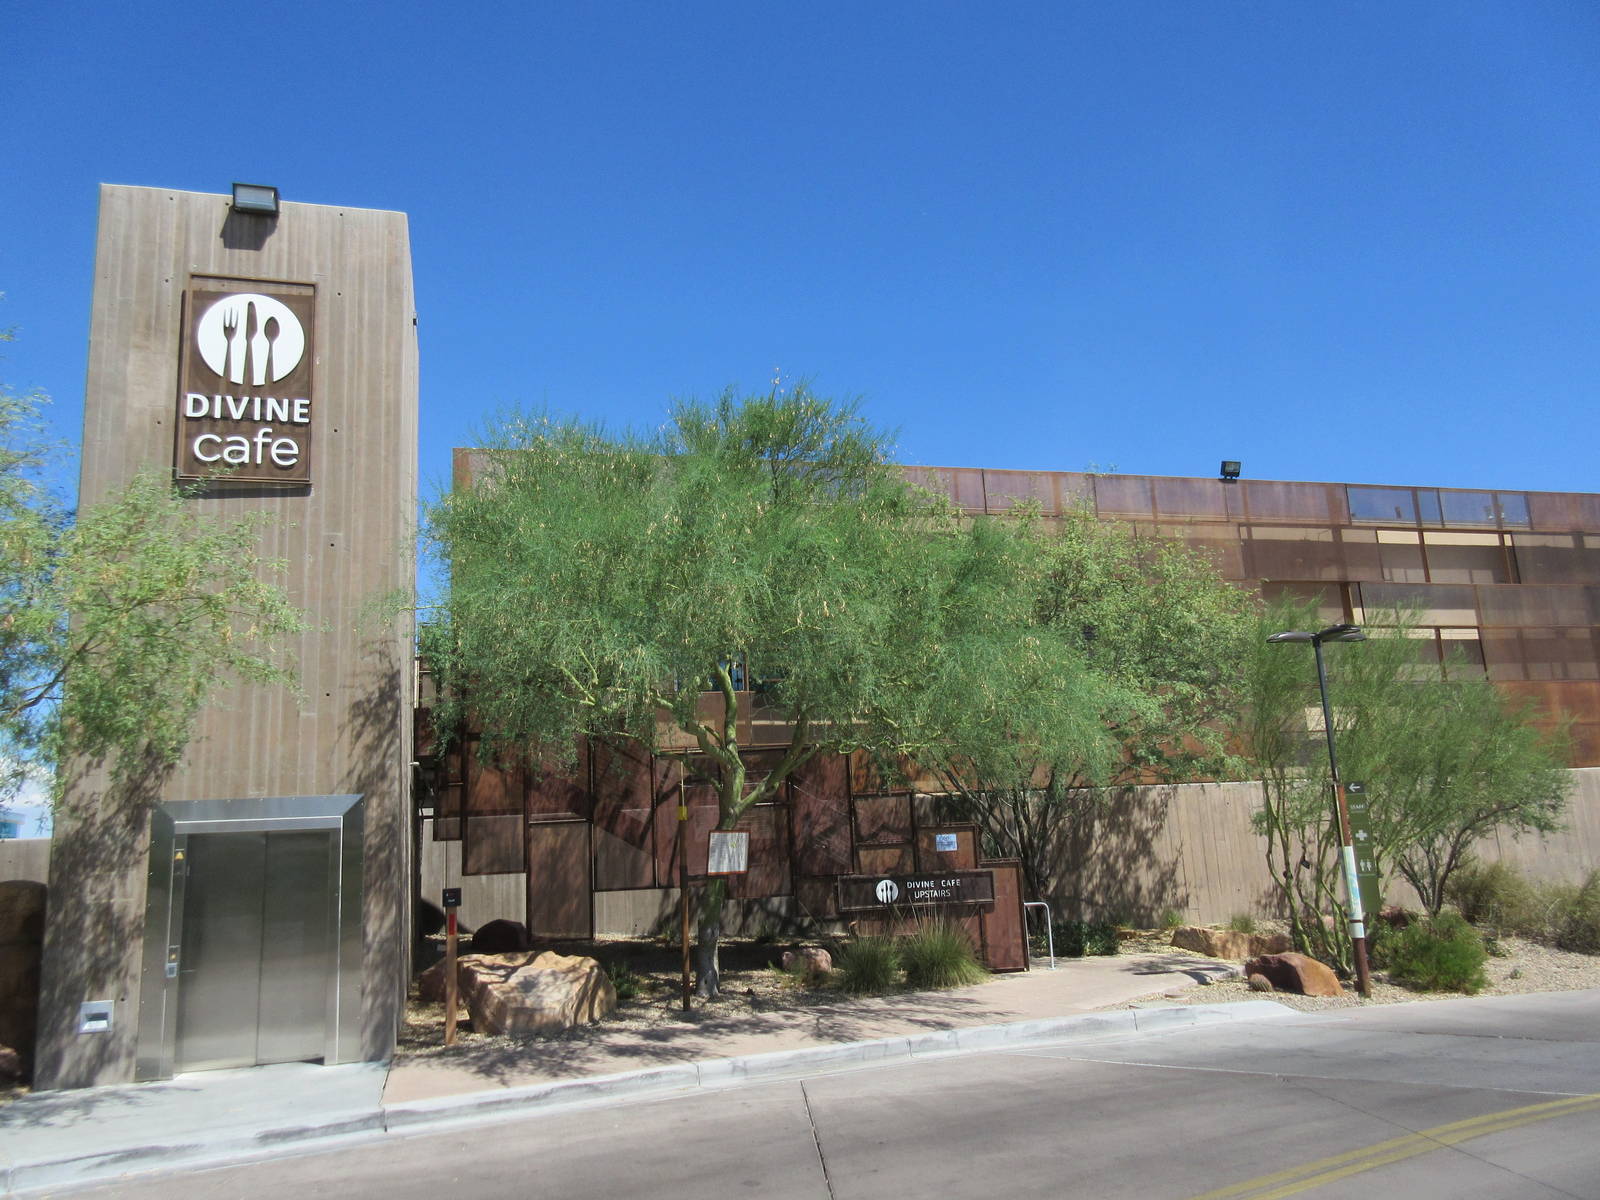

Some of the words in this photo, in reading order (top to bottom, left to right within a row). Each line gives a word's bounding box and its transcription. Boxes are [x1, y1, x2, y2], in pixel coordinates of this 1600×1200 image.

[185, 393, 310, 423] DIVINE
[193, 428, 299, 466] cafe
[906, 880, 934, 888] DIVINE
[941, 879, 960, 887] CAFE
[914, 889, 950, 898] UPSTAIRS
